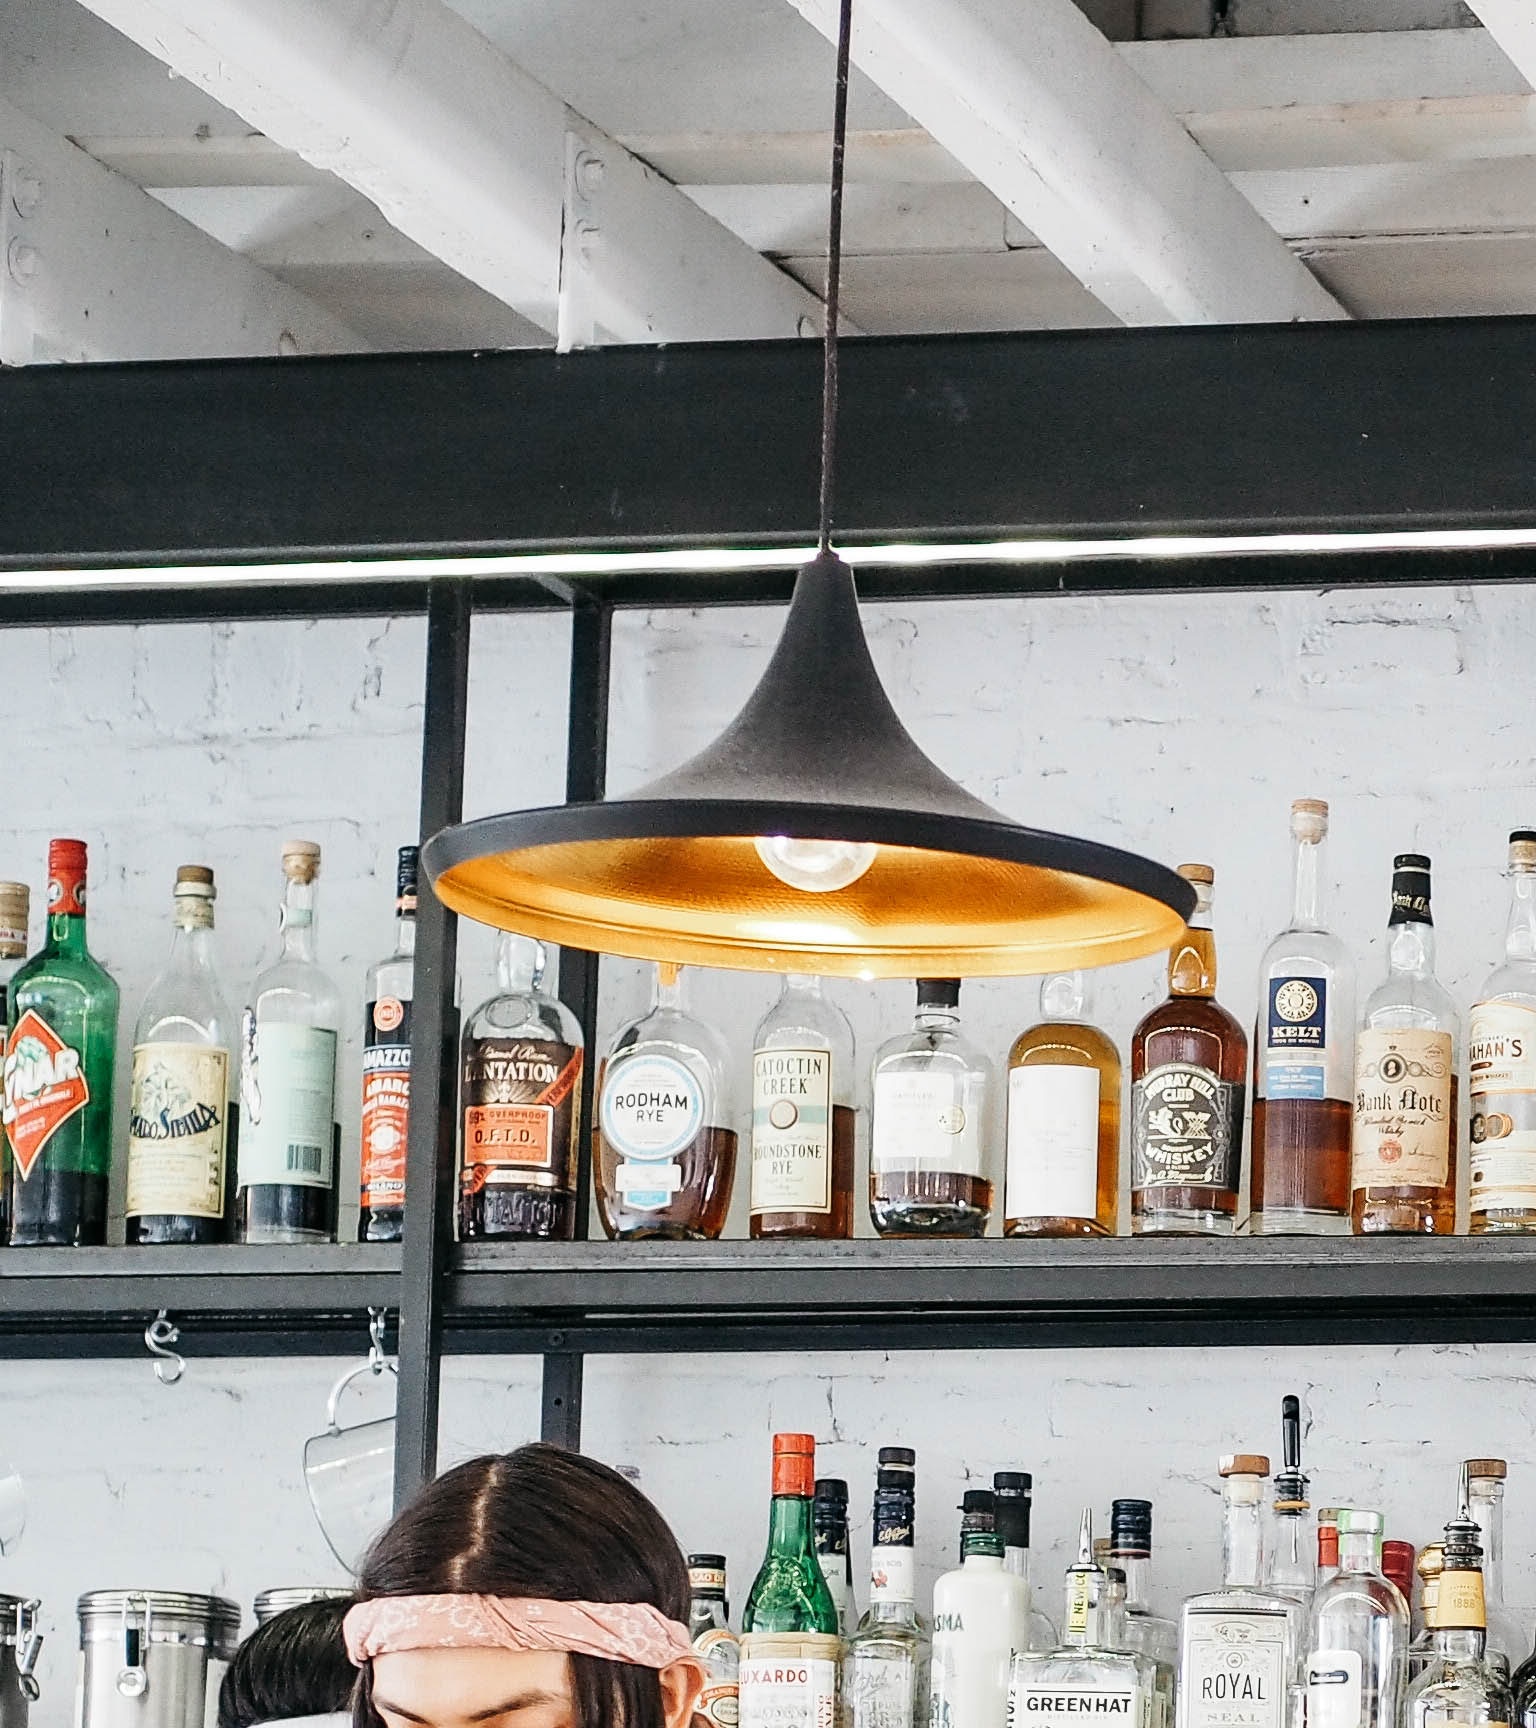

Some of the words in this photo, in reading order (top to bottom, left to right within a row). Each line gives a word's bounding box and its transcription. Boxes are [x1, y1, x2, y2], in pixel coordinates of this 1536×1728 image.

[1271, 1026, 1322, 1038] KELT
[464, 1060, 559, 1084] LNTATION
[755, 1057, 822, 1076] CATOCTIN
[762, 1077, 809, 1096] CREEK
[1161, 1088, 1195, 1102] CLUB
[615, 1094, 689, 1111] RODHAM
[636, 1109, 665, 1124] RYE
[1145, 1141, 1214, 1165] WHISKEY
[771, 1160, 794, 1176] RYE
[739, 1668, 808, 1685] LUXARDO
[1202, 1673, 1267, 1700] ROYAL
[1026, 1697, 1092, 1713] GREEN
[1095, 1698, 1132, 1713] HAT
[1207, 1712, 1261, 1723] SEAL
